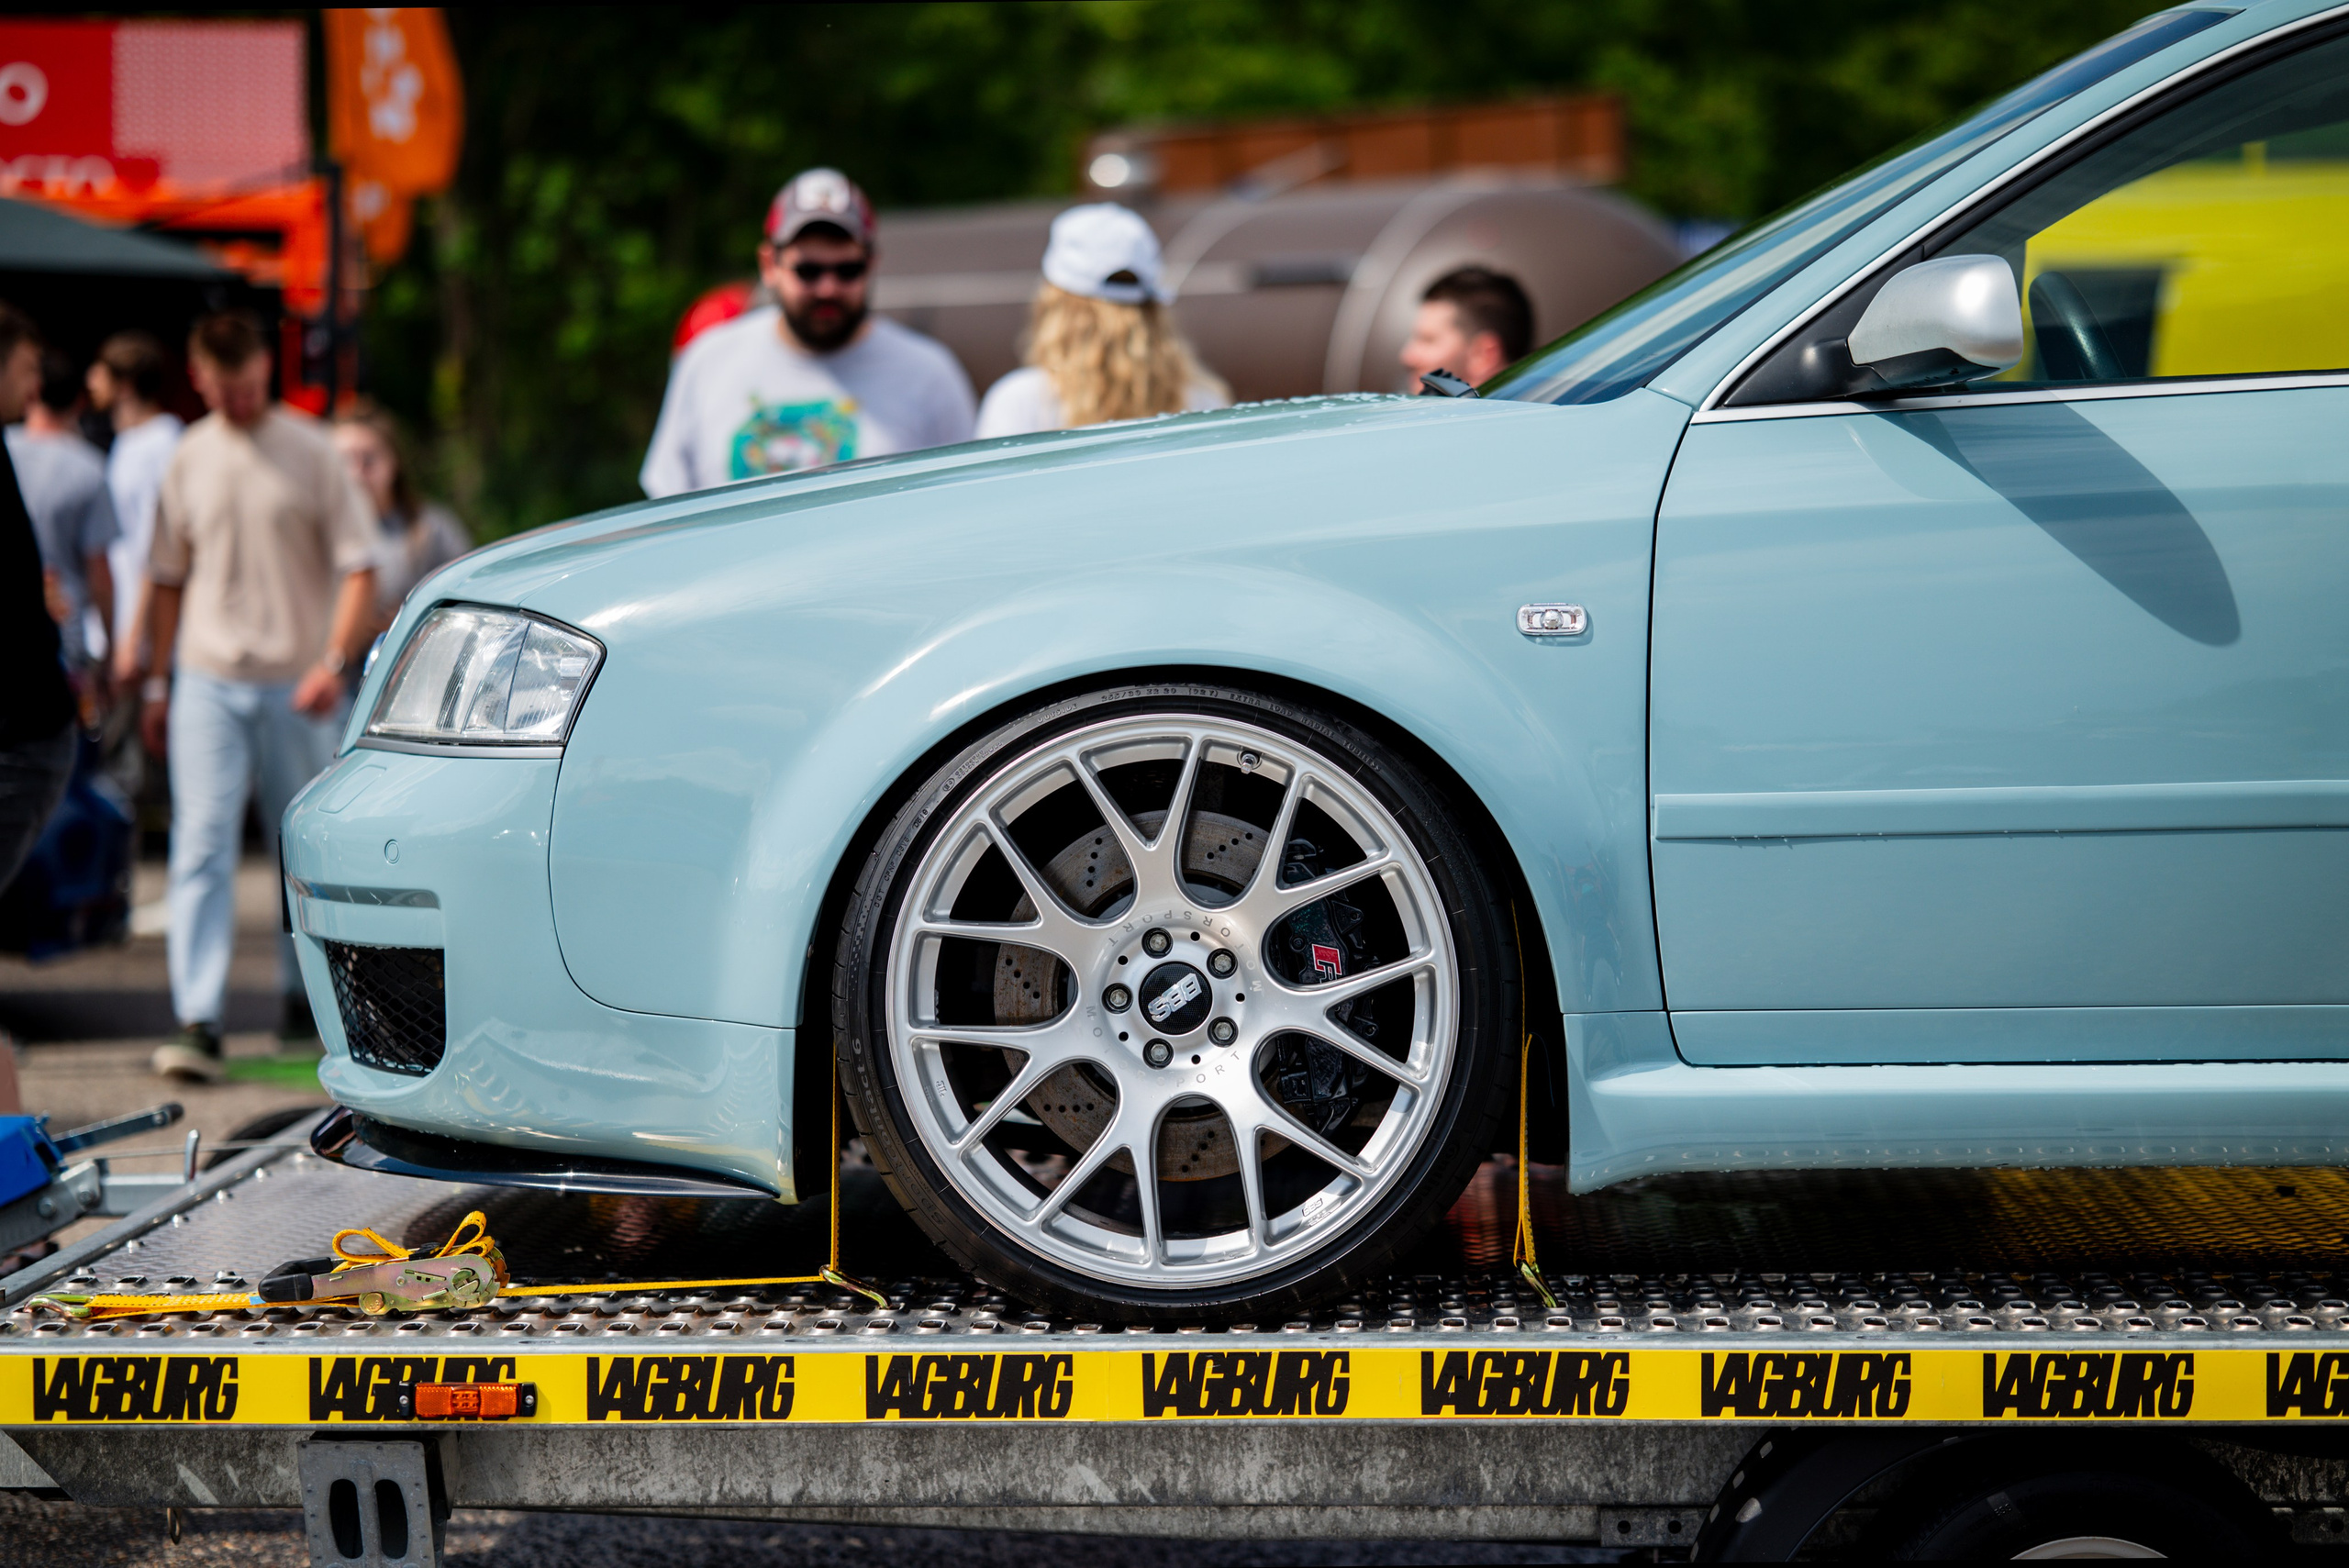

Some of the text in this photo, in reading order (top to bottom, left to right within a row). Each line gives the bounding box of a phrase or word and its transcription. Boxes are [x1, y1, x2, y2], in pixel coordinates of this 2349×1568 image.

[1037, 703, 1078, 723] OUTSIDE
[1229, 693, 1262, 706] EXTRA
[1268, 703, 1293, 717] LOAD
[1299, 716, 1335, 739] RADIAL
[874, 887, 885, 908] DOT
[1148, 973, 1202, 1022] BBS
[851, 1037, 862, 1056] 6
[2266, 1352, 2349, 1417] VAG
